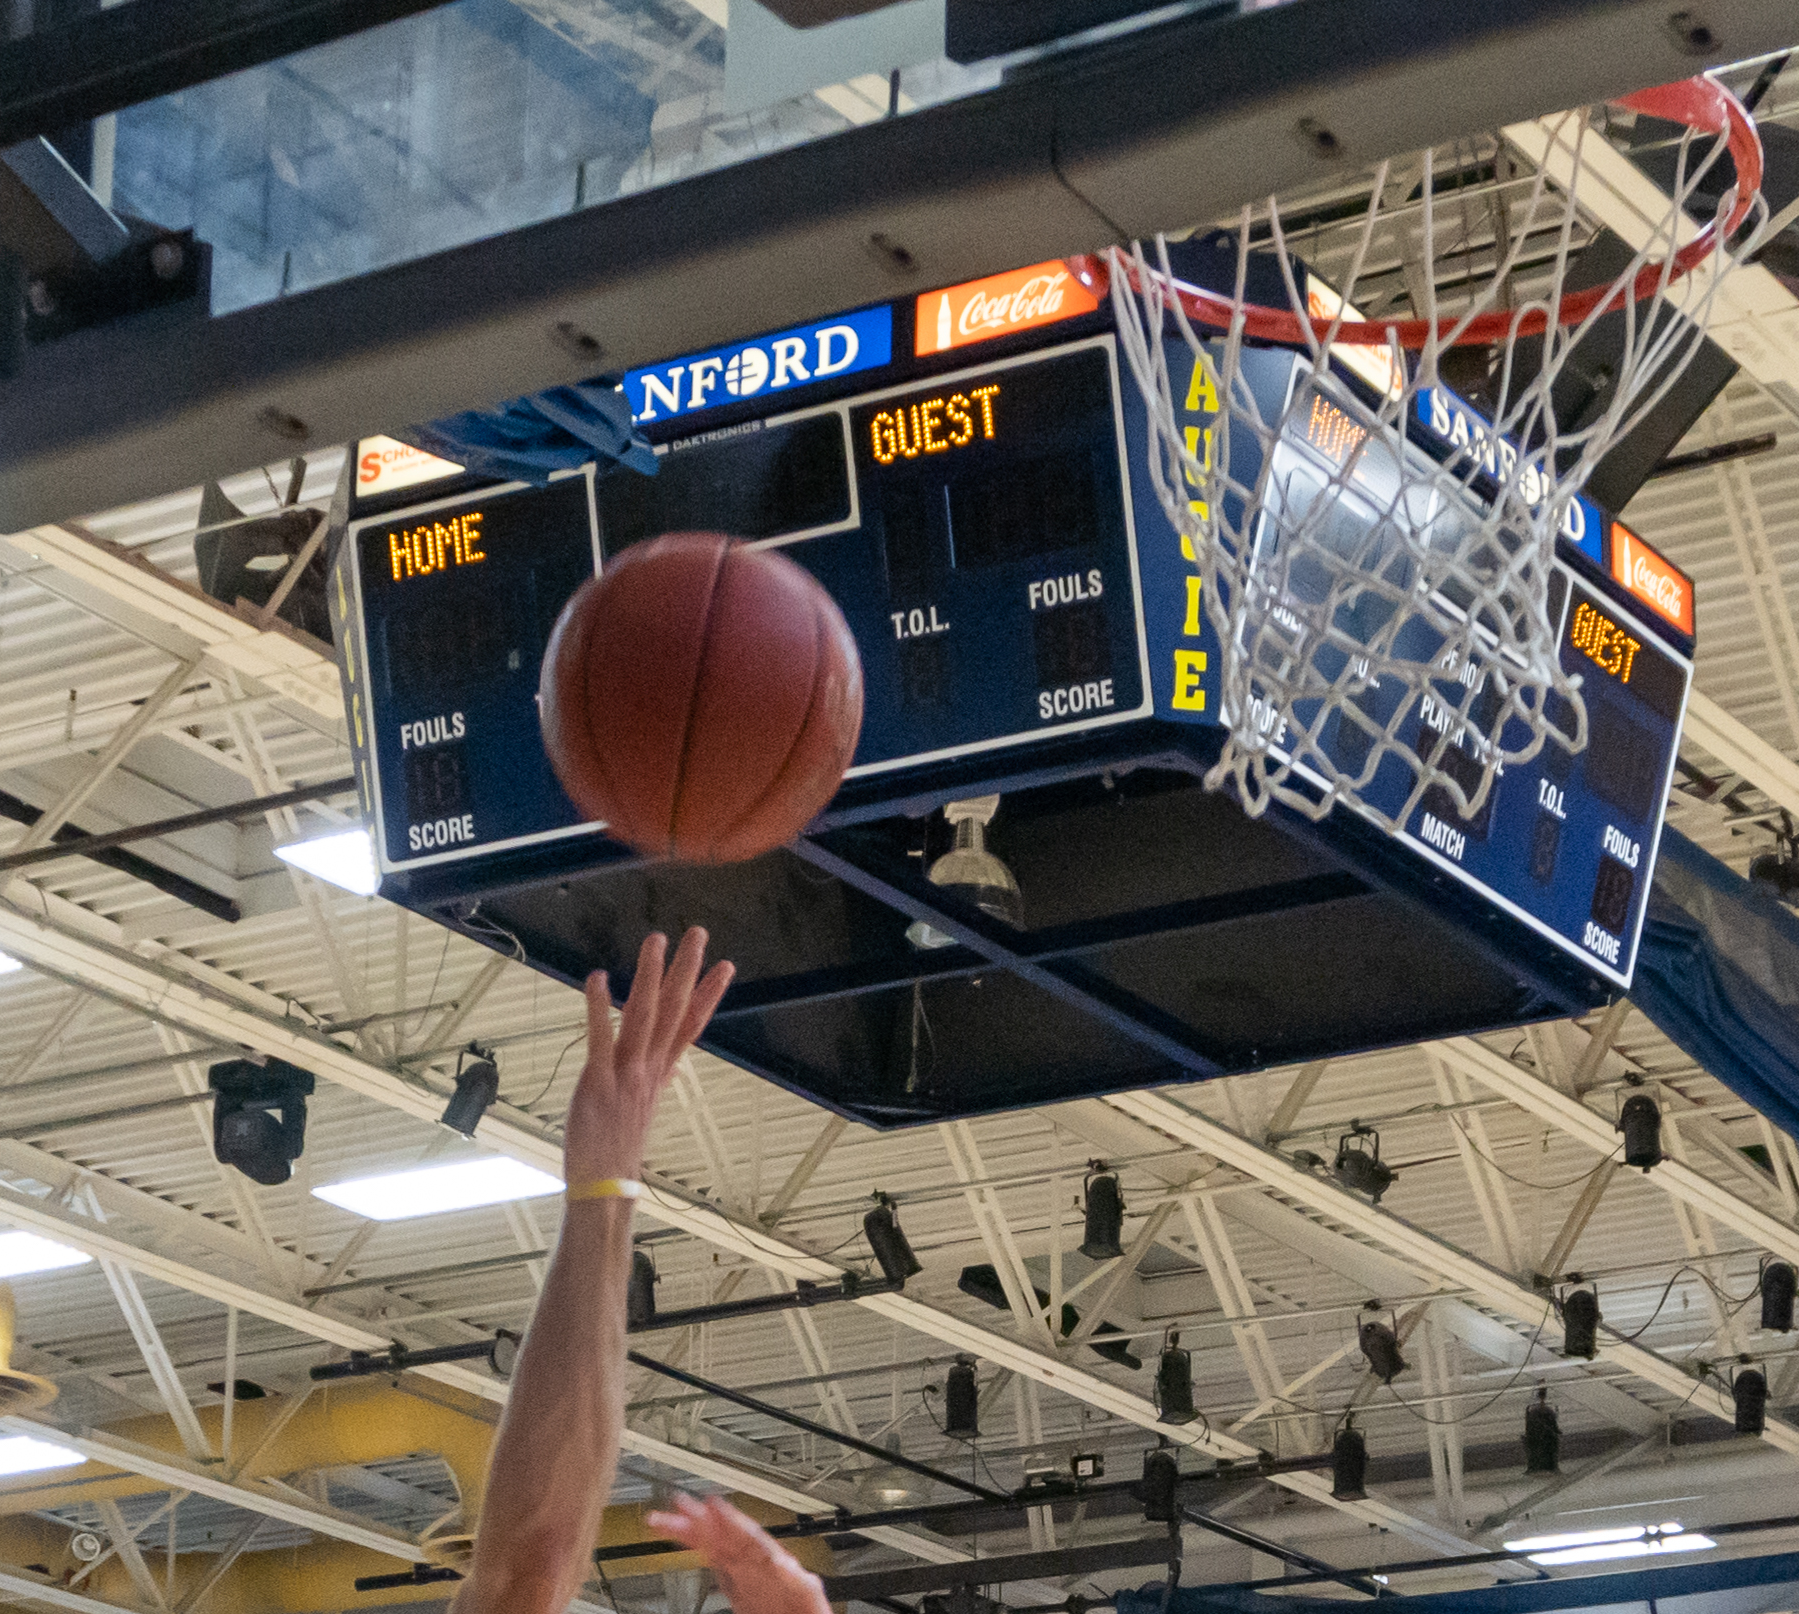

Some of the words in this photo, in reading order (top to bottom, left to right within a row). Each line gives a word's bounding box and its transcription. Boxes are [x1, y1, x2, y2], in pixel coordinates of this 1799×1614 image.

[631, 324, 859, 422] NFORD
[871, 384, 999, 465] GUEST
[1308, 394, 1373, 462] HOM
[359, 444, 425, 483] SCHO
[1430, 388, 1586, 542] SANFOD
[389, 513, 486, 582] HOME
[1028, 568, 1103, 610] FOULS
[891, 606, 950, 639] T.O.L.
[1572, 603, 1641, 684] GUEST
[1039, 679, 1115, 719] SCORE
[401, 711, 466, 750] FOULS
[1539, 778, 1567, 819] T.O.L.
[408, 815, 475, 851] SCORE
[1421, 812, 1466, 860] MATCH
[1604, 824, 1640, 868] FOULS
[1583, 921, 1621, 965] SCORE
